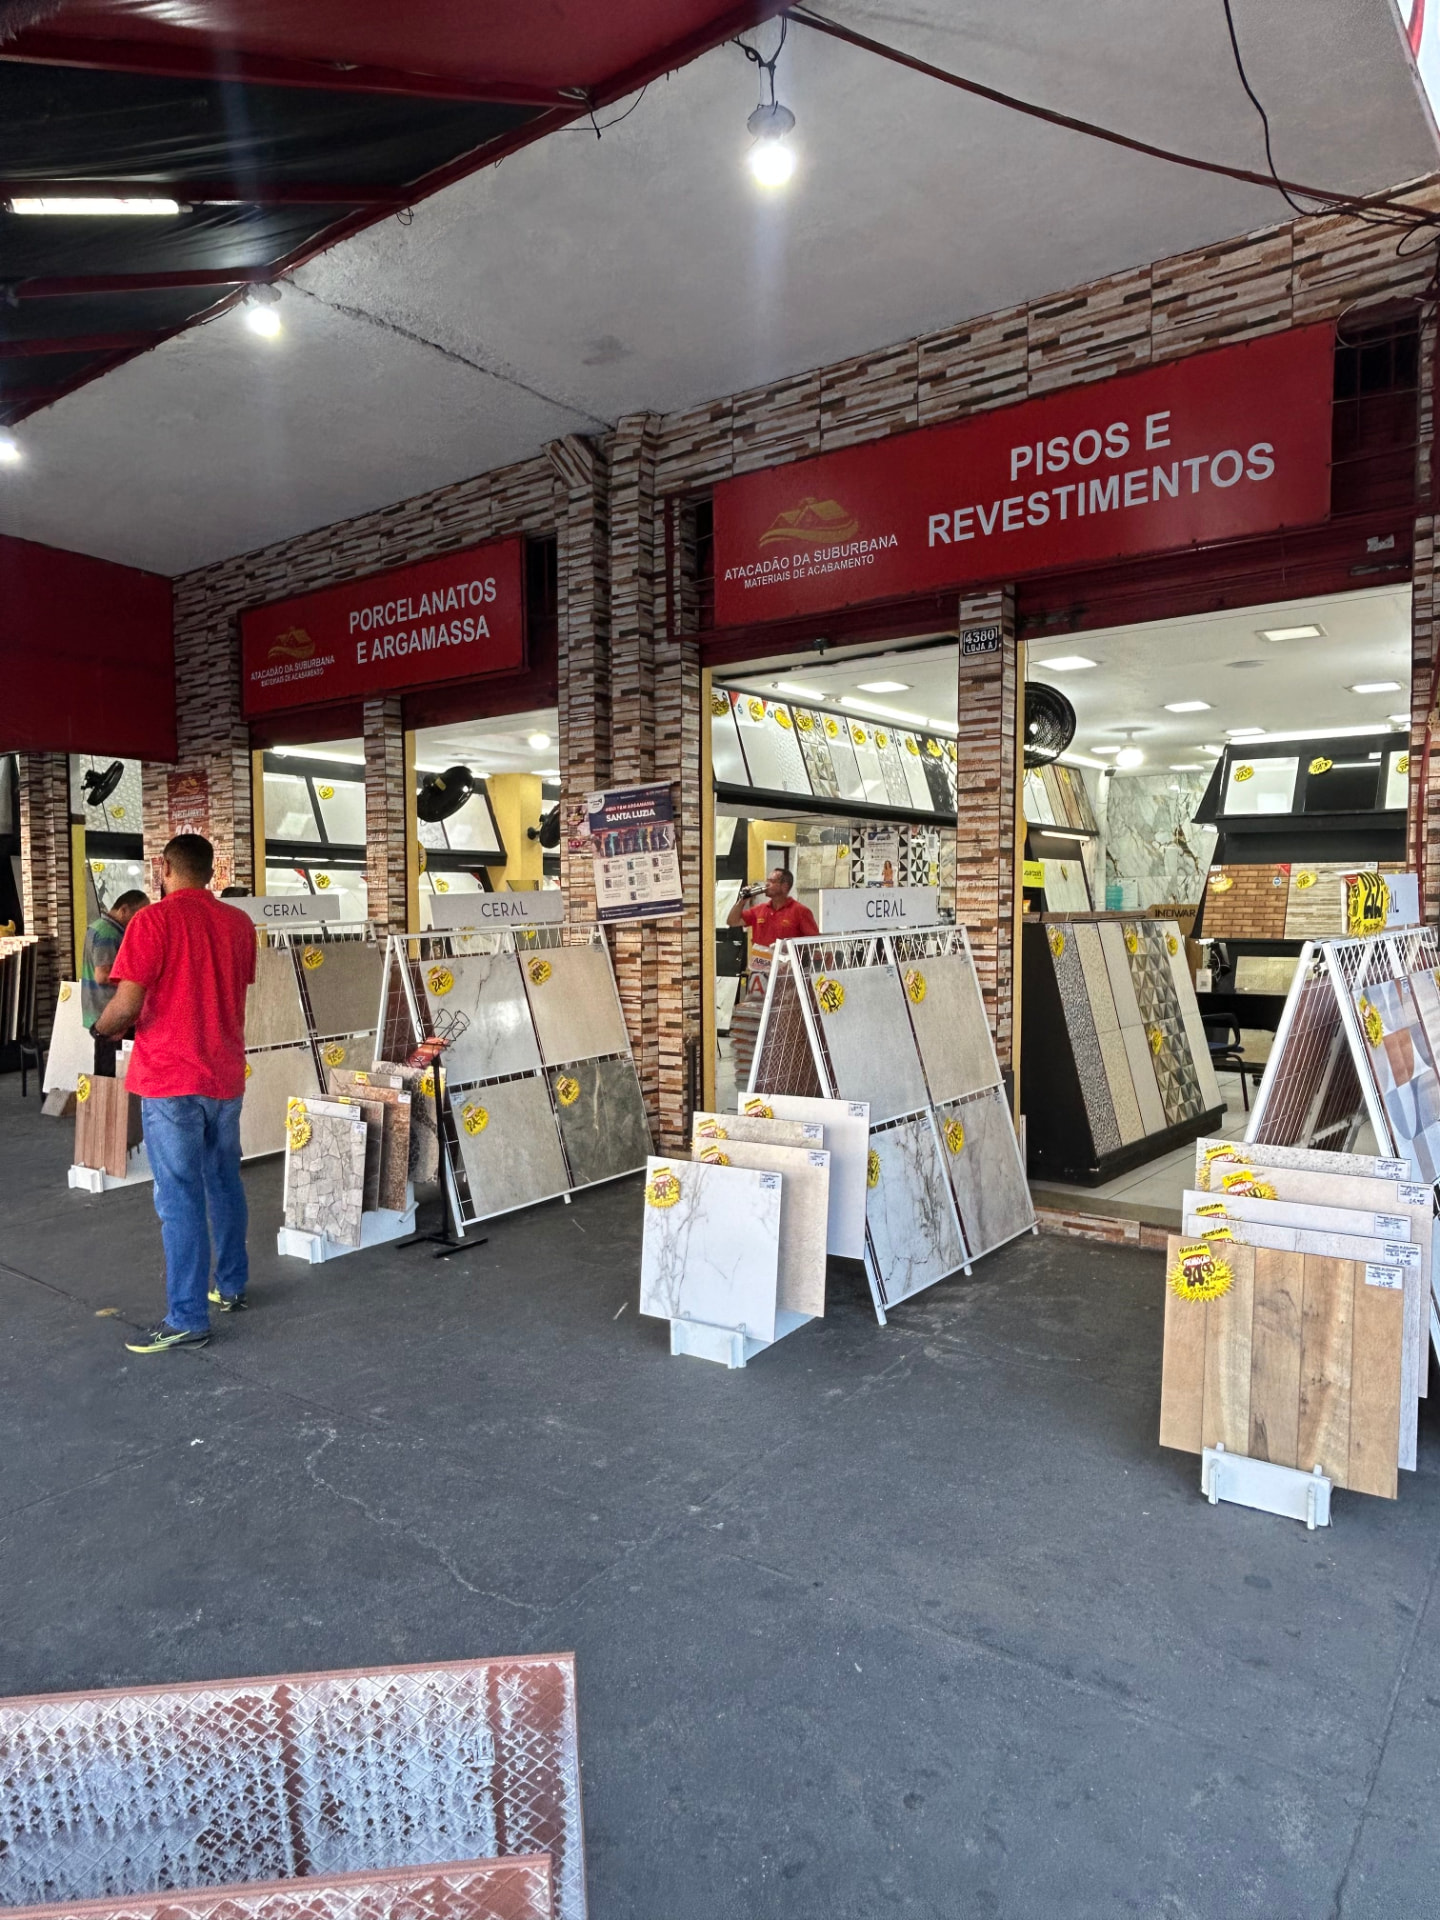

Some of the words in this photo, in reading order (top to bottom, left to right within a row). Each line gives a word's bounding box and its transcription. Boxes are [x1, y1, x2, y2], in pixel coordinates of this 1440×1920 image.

[1010, 421, 1131, 481] PISOS
[1145, 411, 1171, 450] E
[928, 442, 1275, 547] REVESTIMENTOS
[724, 556, 790, 581] ATACADÃO
[793, 553, 811, 567] DA
[814, 534, 898, 562] SUBURBANA
[744, 571, 791, 589] MATERIAIS
[793, 568, 806, 579] DE
[807, 554, 875, 577] ACABAMENTO
[349, 577, 497, 635] PORCELANATOS
[357, 641, 367, 664] E
[371, 615, 490, 661] ARGAMASSA
[965, 629, 995, 644] 4380
[606, 812, 631, 822] SANTA
[632, 808, 656, 818] LUZIA
[263, 903, 308, 917] CERAL
[481, 901, 528, 918] CERAL
[866, 898, 906, 918] CERAL
